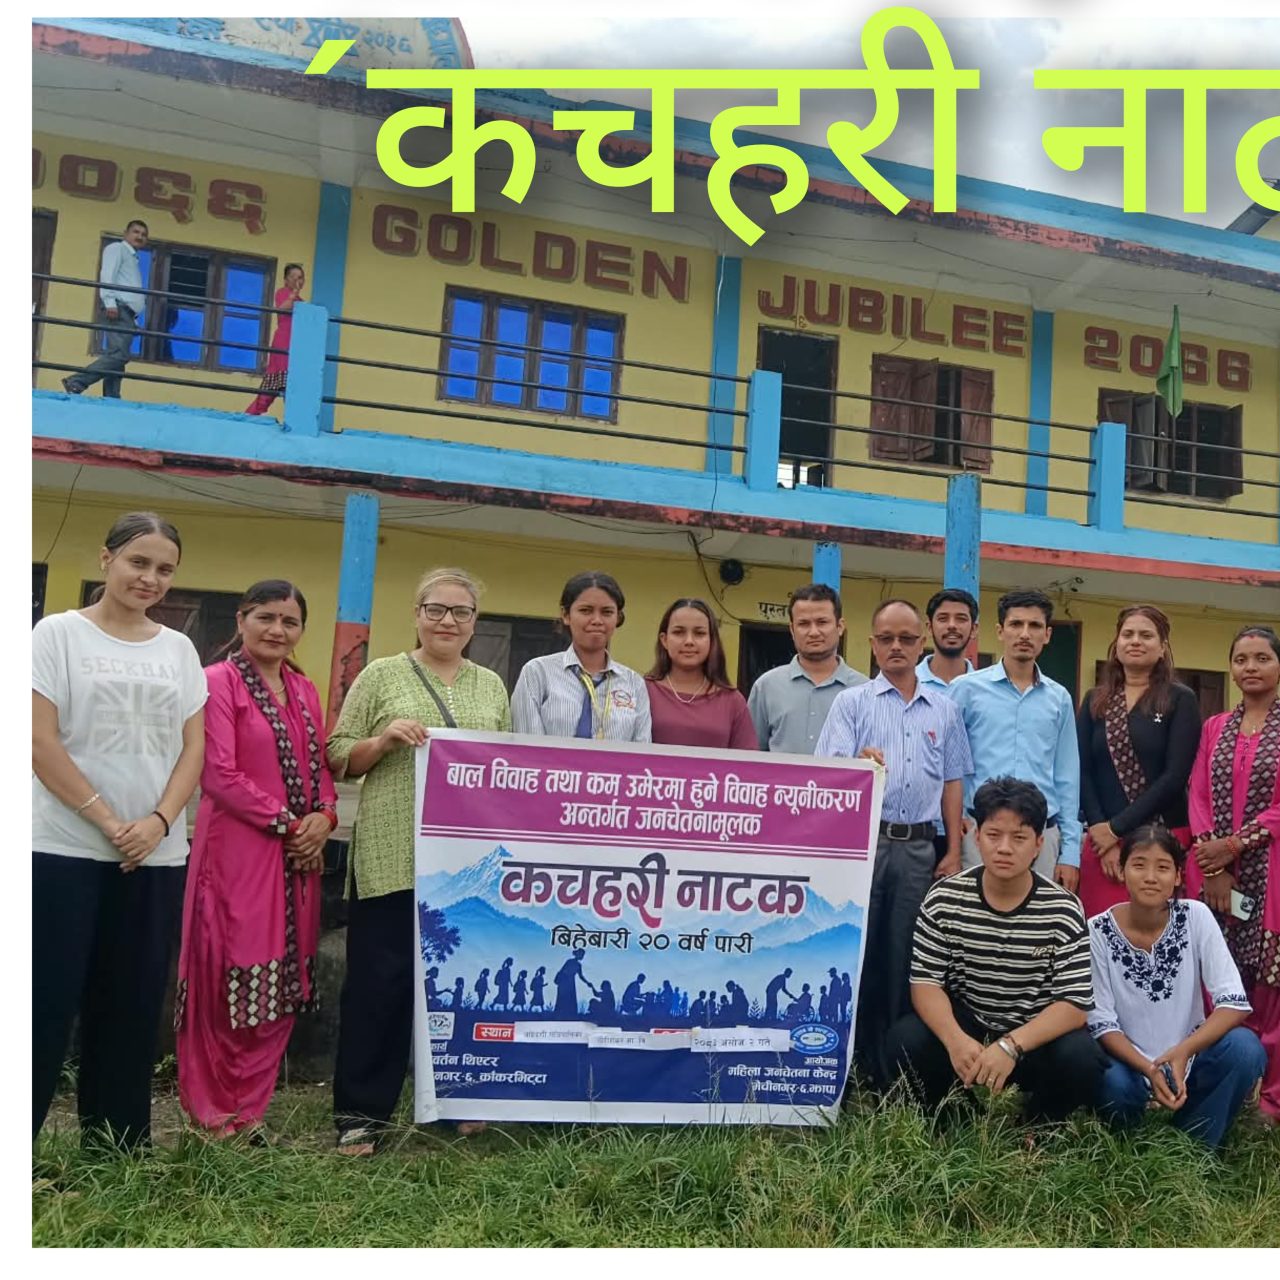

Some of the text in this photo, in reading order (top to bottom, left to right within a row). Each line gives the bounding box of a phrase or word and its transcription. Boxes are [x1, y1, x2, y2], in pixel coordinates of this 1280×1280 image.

[32, 148, 268, 236] ०६६
[372, 204, 1252, 392] GOLDEN JUBILEE 2066
[447, 758, 863, 816] बाल विवाह तथा कम उमेरमा हुने विवाह न्यूनीकरण
[559, 799, 763, 842] अन्तर्गत जनचेतनामूलक
[501, 852, 810, 929] कचहरी नाटक
[551, 923, 754, 954] बिहेबारी २० वर्ष पारी
[480, 1026, 512, 1038] स्थान
[432, 1053, 460, 1066] वर्तन
[728, 1064, 761, 1077] महिला
[764, 1066, 810, 1078] जनचेतना
